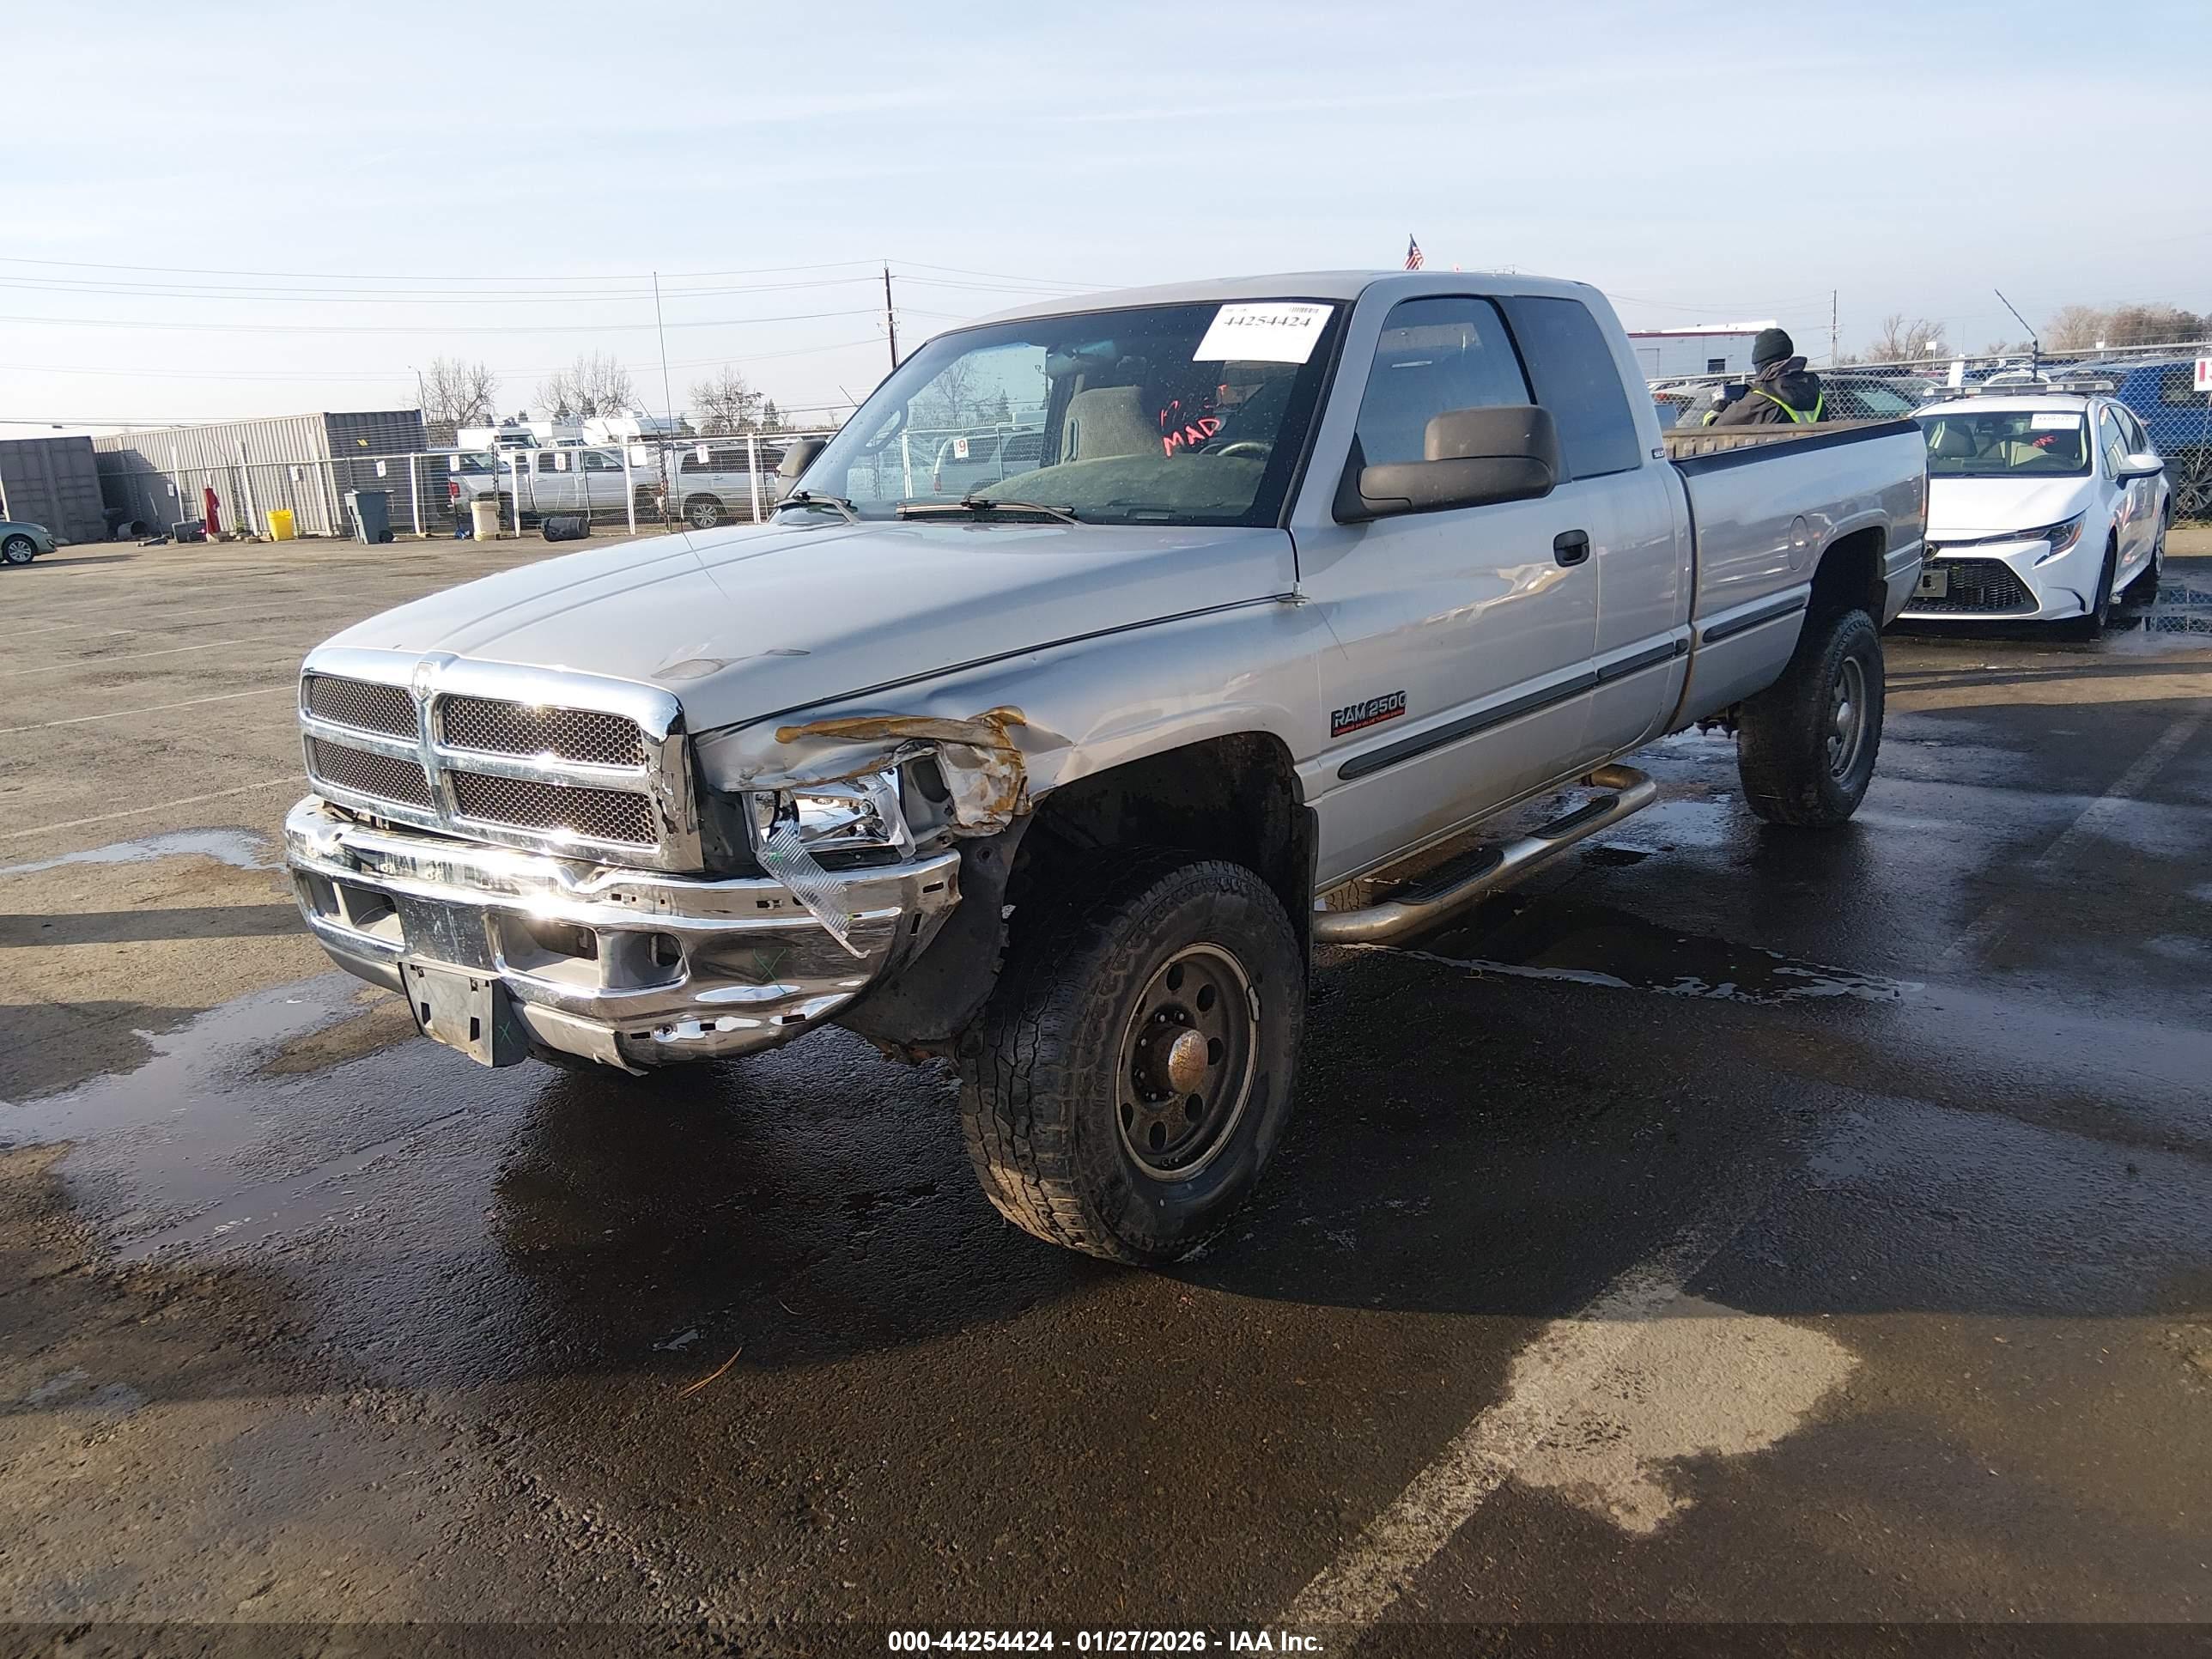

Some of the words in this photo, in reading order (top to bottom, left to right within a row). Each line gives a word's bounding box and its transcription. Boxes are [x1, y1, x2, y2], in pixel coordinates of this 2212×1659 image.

[1224, 316, 1311, 327] 44254424
[2199, 361, 2212, 382] 1
[1164, 417, 1221, 458] MAD
[958, 440, 967, 453] 9
[557, 458, 563, 468] 6
[1334, 704, 1366, 728] RAM
[1368, 691, 1407, 718] 2500
